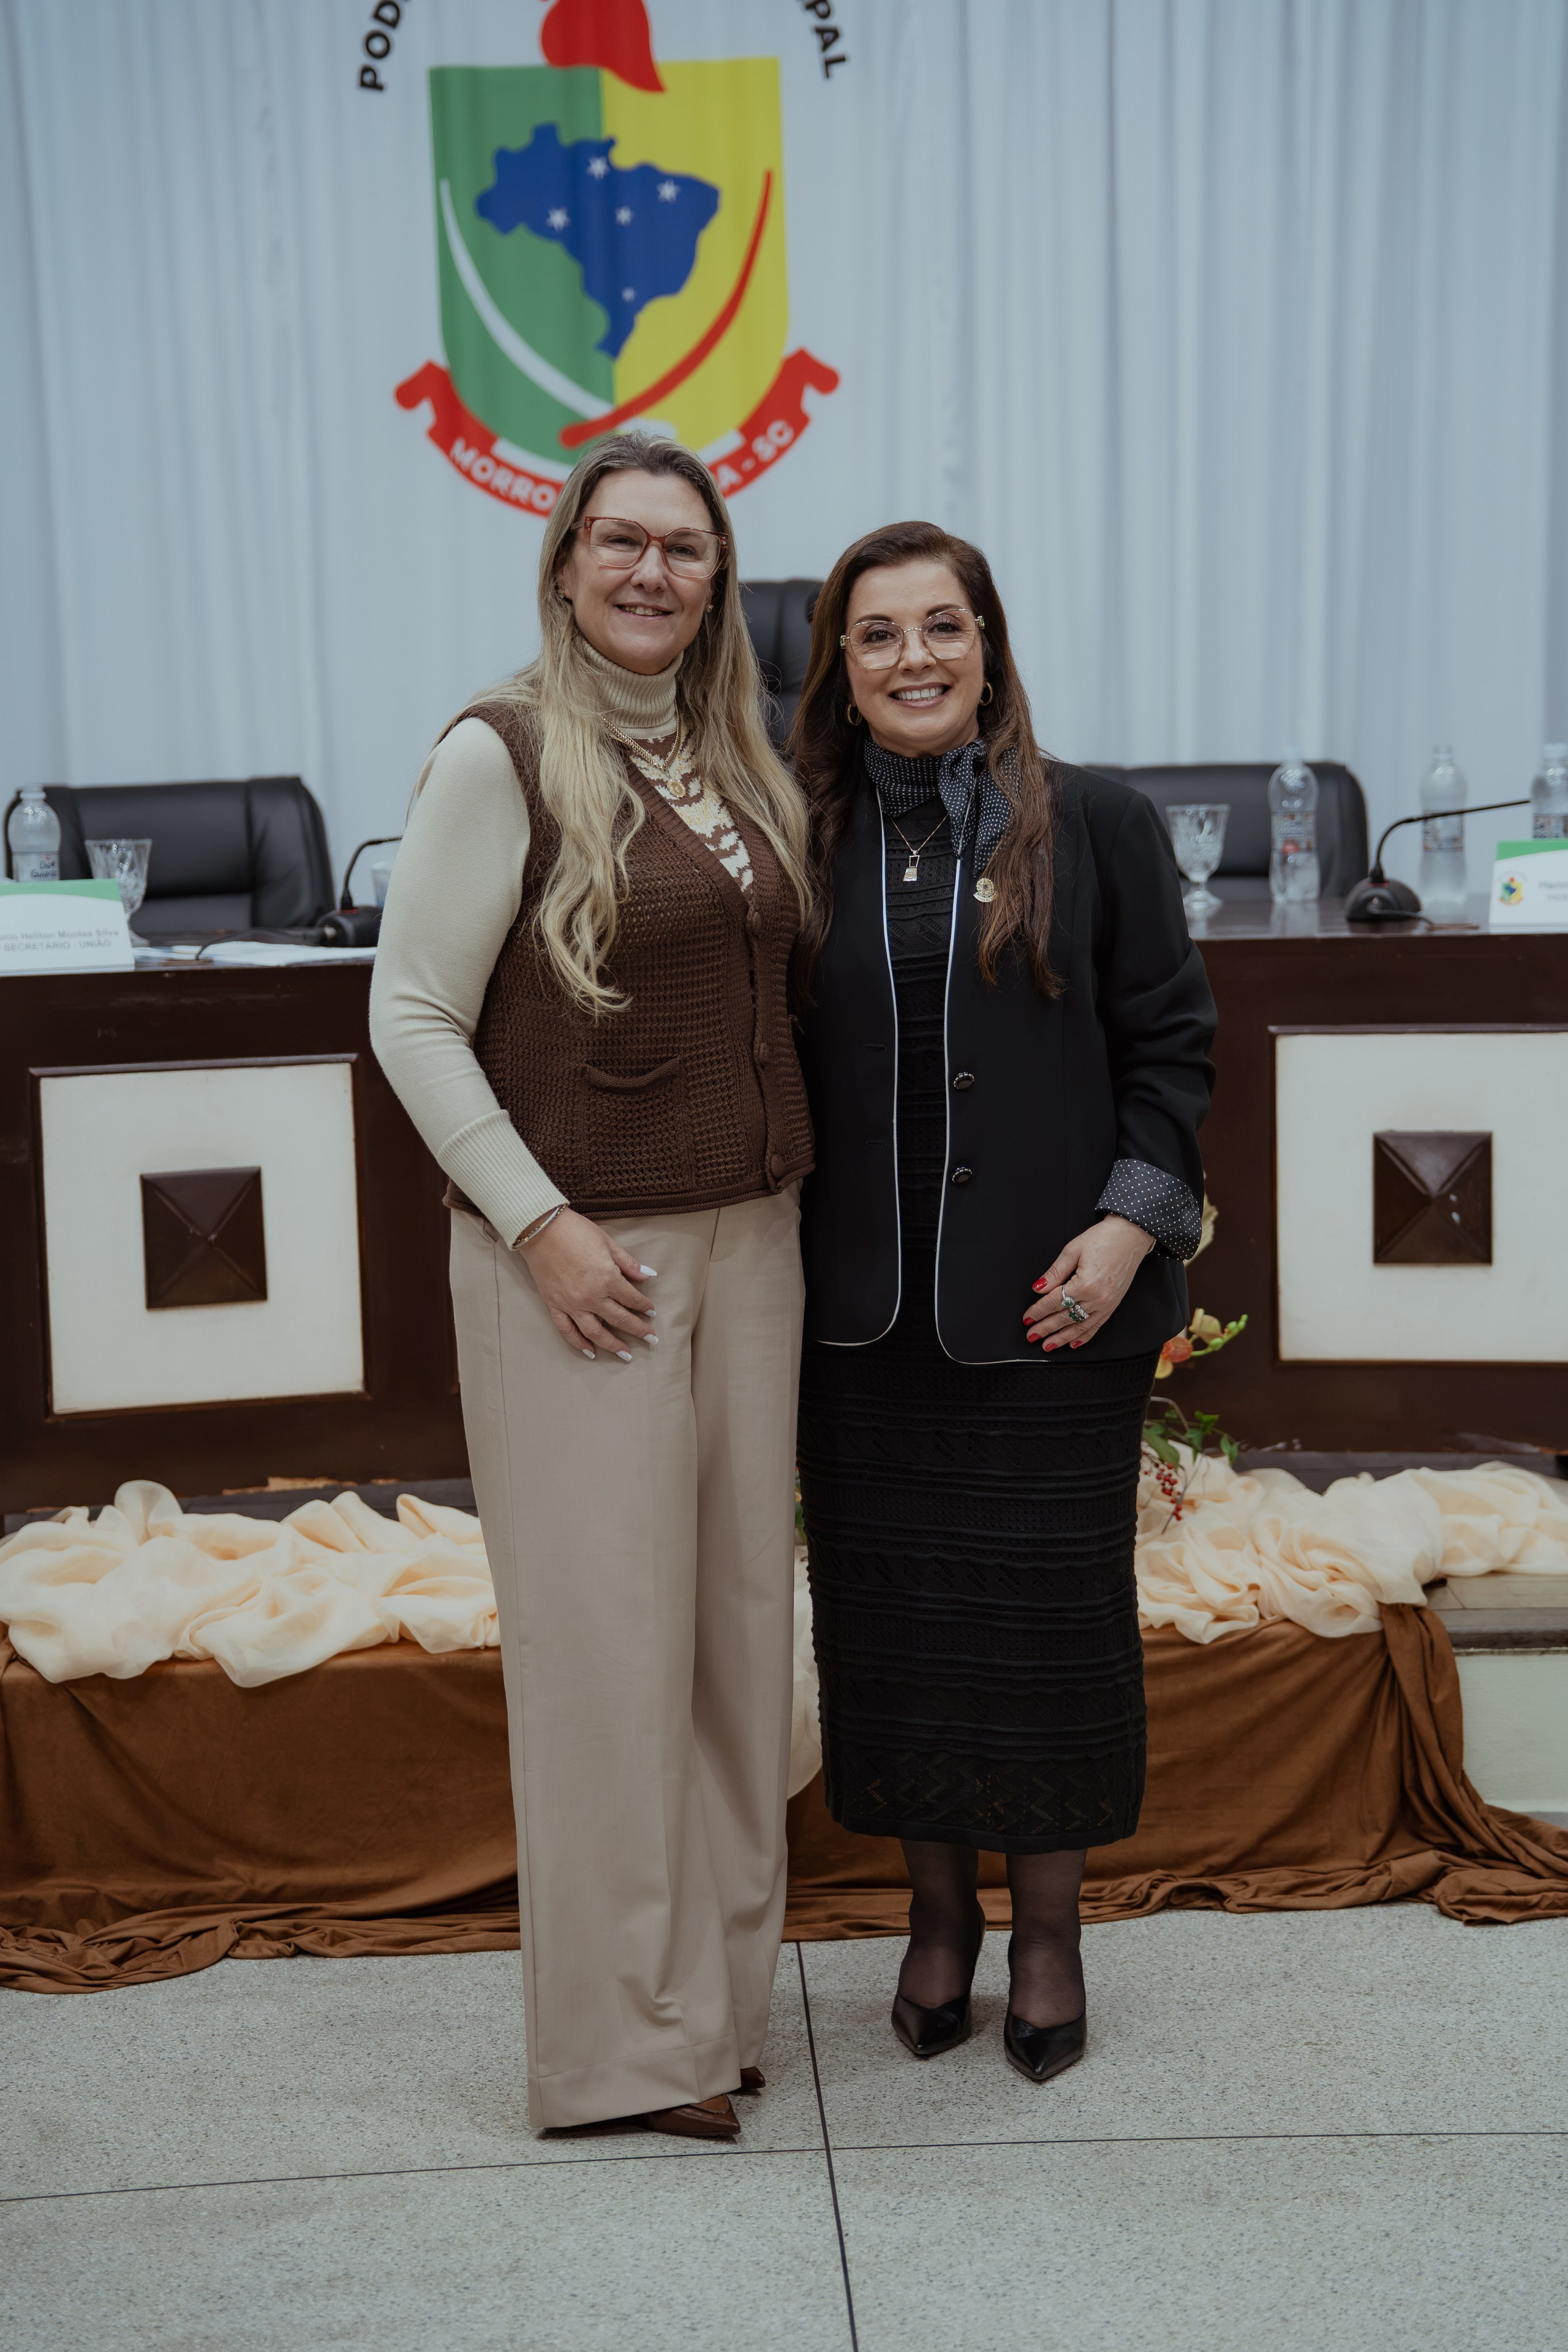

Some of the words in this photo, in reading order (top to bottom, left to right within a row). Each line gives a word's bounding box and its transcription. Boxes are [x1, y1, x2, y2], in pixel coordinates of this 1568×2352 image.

[358, 0, 403, 92] POD
[804, 0, 849, 80] PAL
[450, 435, 557, 511] MORRO
[717, 463, 744, 491] A
[751, 419, 795, 463] SC
